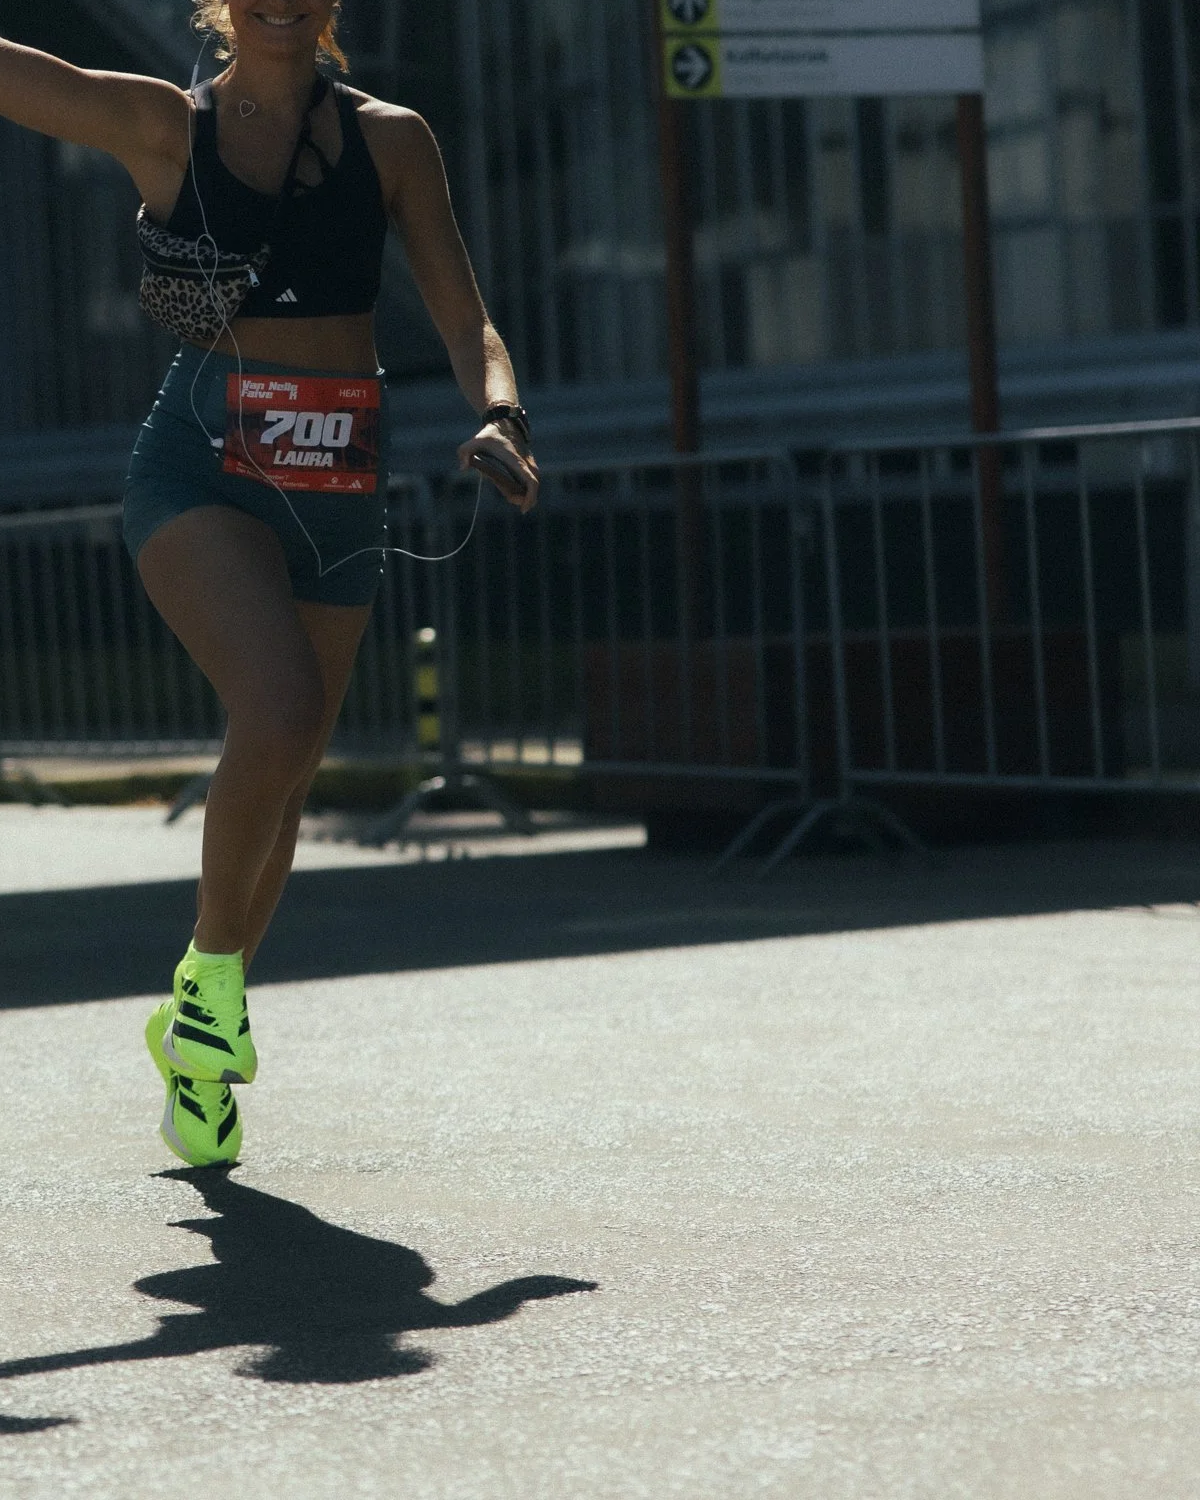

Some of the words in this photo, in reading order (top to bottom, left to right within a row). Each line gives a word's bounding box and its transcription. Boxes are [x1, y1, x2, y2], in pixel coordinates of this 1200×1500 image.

[242, 380, 265, 391] Van
[269, 381, 298, 392] Nelle
[339, 388, 361, 398] HEAT
[361, 389, 367, 399] 1
[260, 410, 353, 448] 700
[273, 450, 334, 467] LAURA
